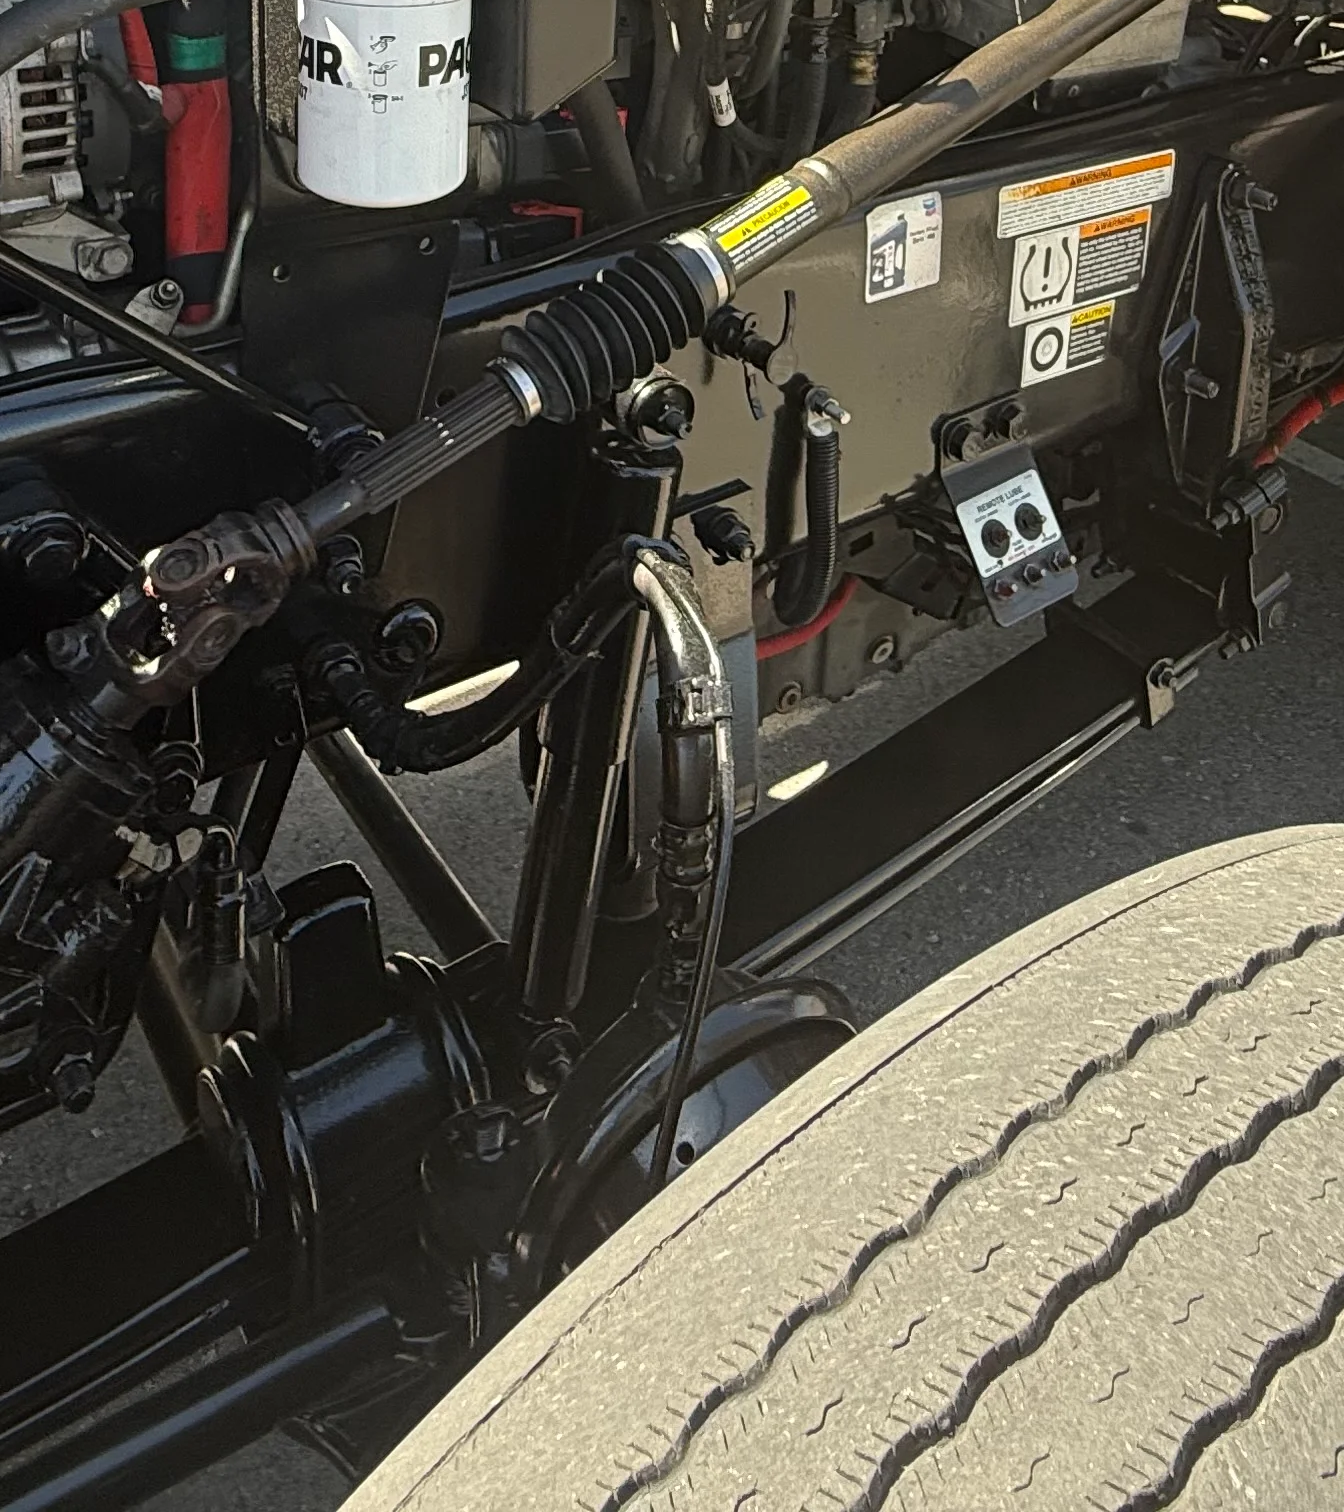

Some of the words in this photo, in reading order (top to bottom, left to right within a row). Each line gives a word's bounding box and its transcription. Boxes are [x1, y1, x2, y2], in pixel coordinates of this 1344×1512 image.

[1076, 168, 1112, 186] WARNING
[1100, 214, 1136, 231] WARNING
[1077, 305, 1112, 323] CAUTION
[976, 494, 1006, 513] REMOTE
[1004, 485, 1024, 500] LUBE
